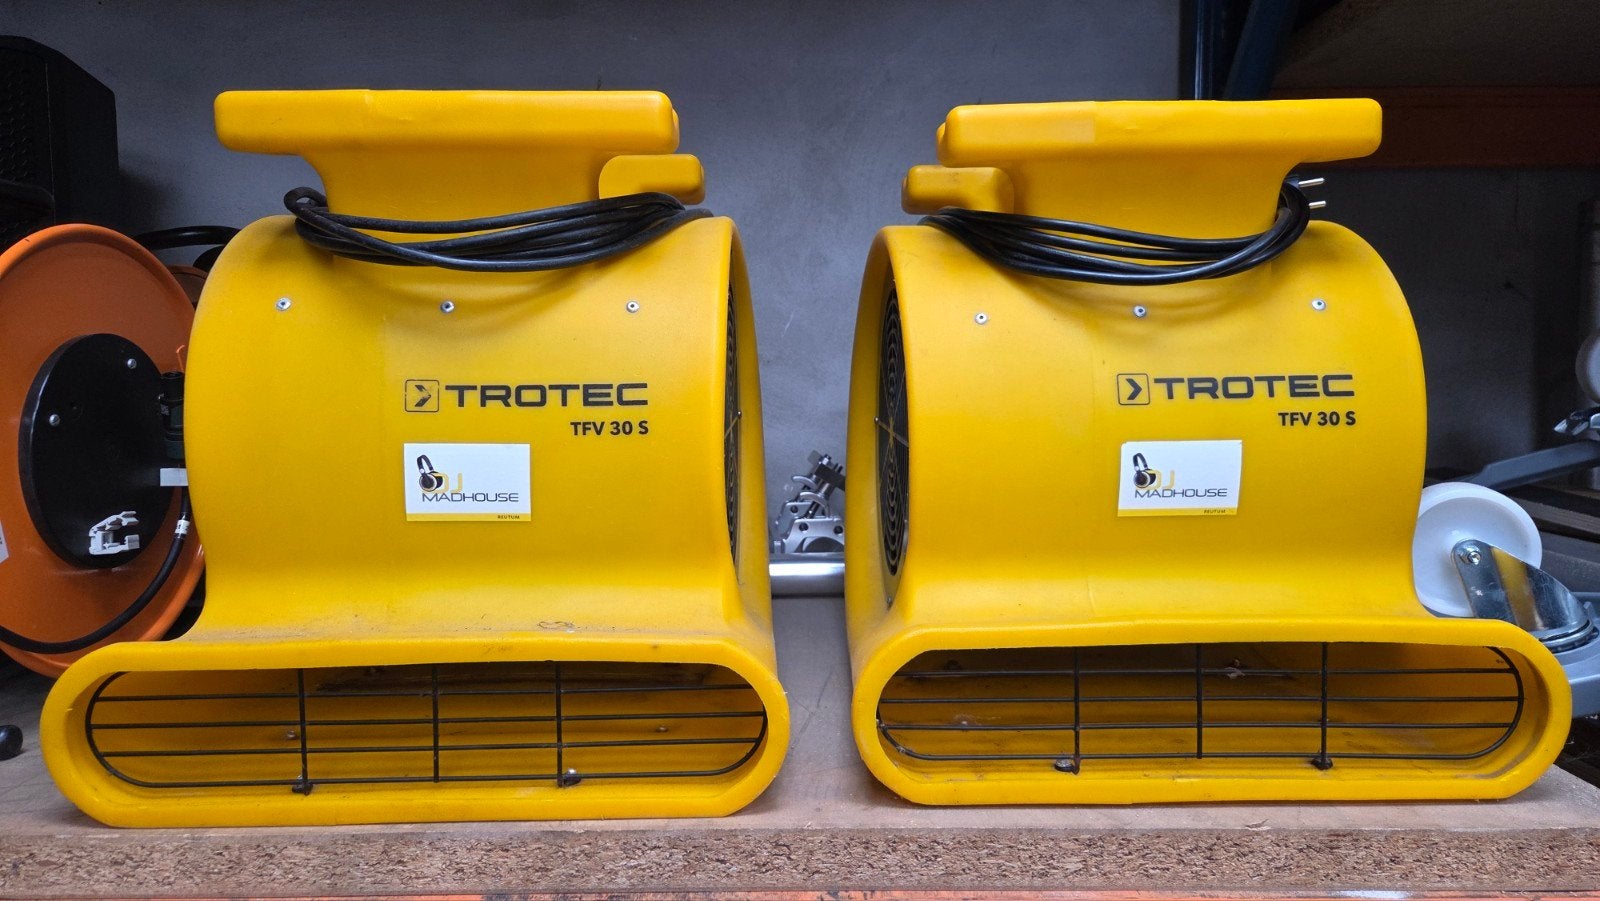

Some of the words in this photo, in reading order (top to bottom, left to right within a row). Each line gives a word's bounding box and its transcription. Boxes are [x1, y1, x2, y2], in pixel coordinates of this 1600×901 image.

[445, 383, 649, 408] TROTEC
[1153, 374, 1355, 400] TROTEC
[570, 421, 605, 436] TFV
[610, 420, 633, 436] 30
[638, 420, 649, 435] S
[1277, 411, 1312, 427] TFV
[1317, 411, 1341, 426] 30
[1345, 410, 1356, 426] S
[422, 472, 463, 494] DJ
[1136, 469, 1175, 491] DJ
[421, 492, 519, 502] MADHOUSE
[1134, 488, 1228, 498] MADHOUSE
